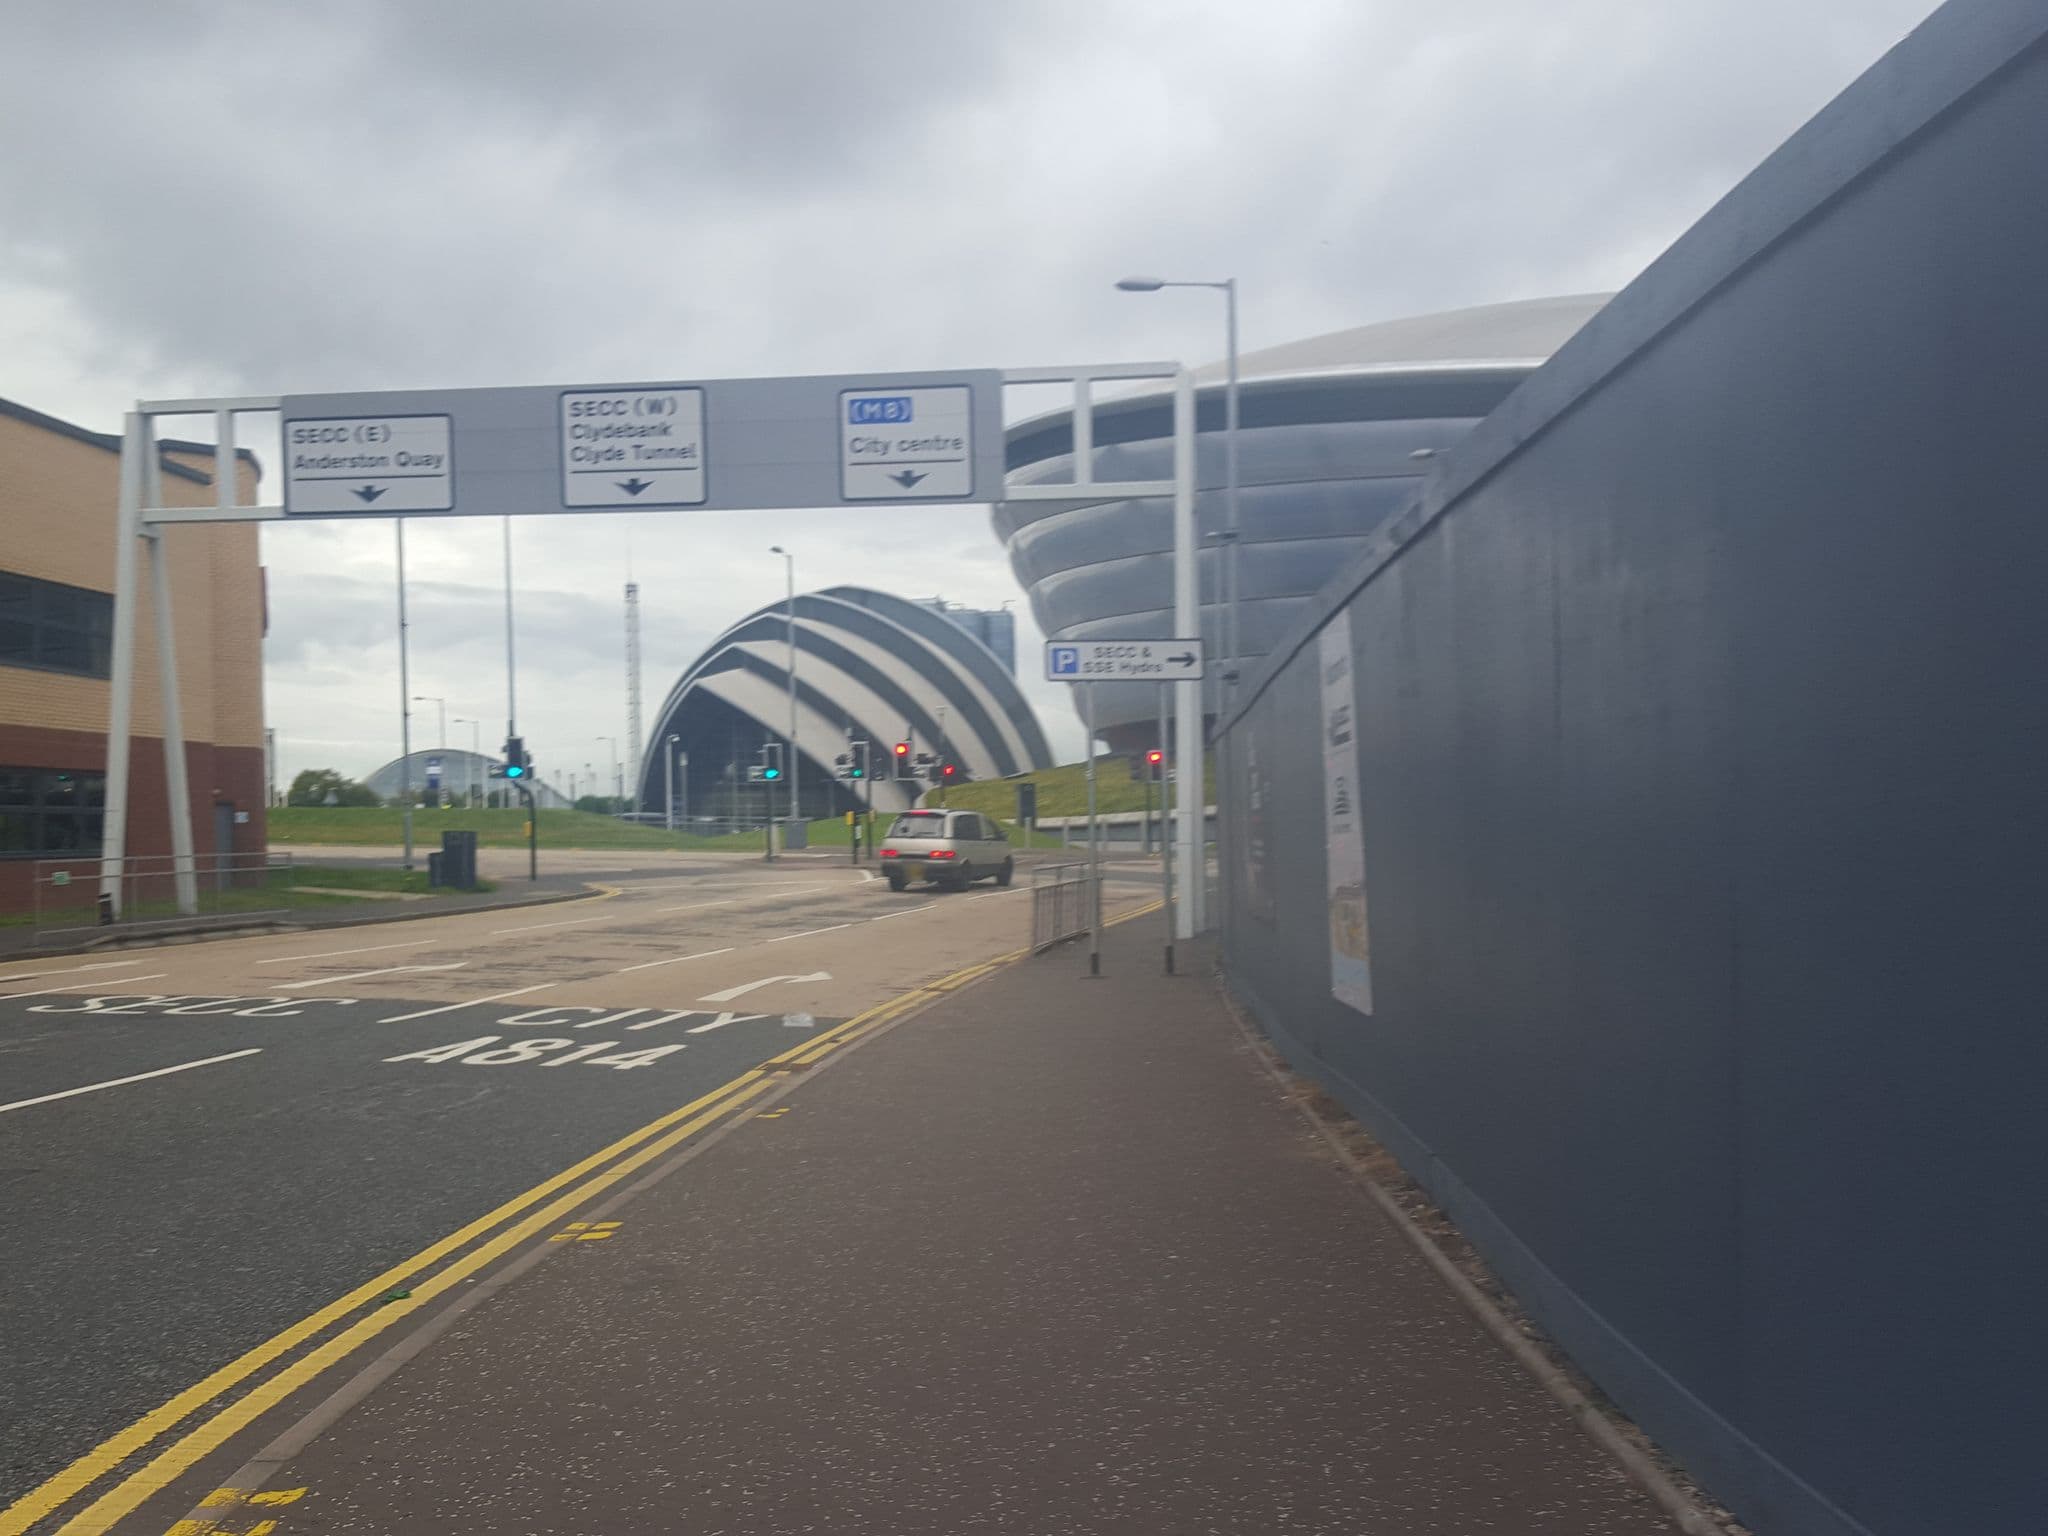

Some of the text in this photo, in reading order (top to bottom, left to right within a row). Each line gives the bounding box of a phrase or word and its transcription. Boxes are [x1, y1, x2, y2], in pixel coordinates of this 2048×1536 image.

[570, 396, 677, 418] SECC (W)
[850, 400, 911, 422] (M8)
[293, 424, 391, 444] SECC (E)
[570, 422, 673, 442] Clydebank
[570, 442, 697, 465] Clyde Tunnel
[851, 434, 963, 456] City centre
[294, 451, 445, 470] Anderston Quay
[1058, 651, 1074, 672] P
[496, 1006, 769, 1033] CITY
[382, 1035, 687, 1070] A814
